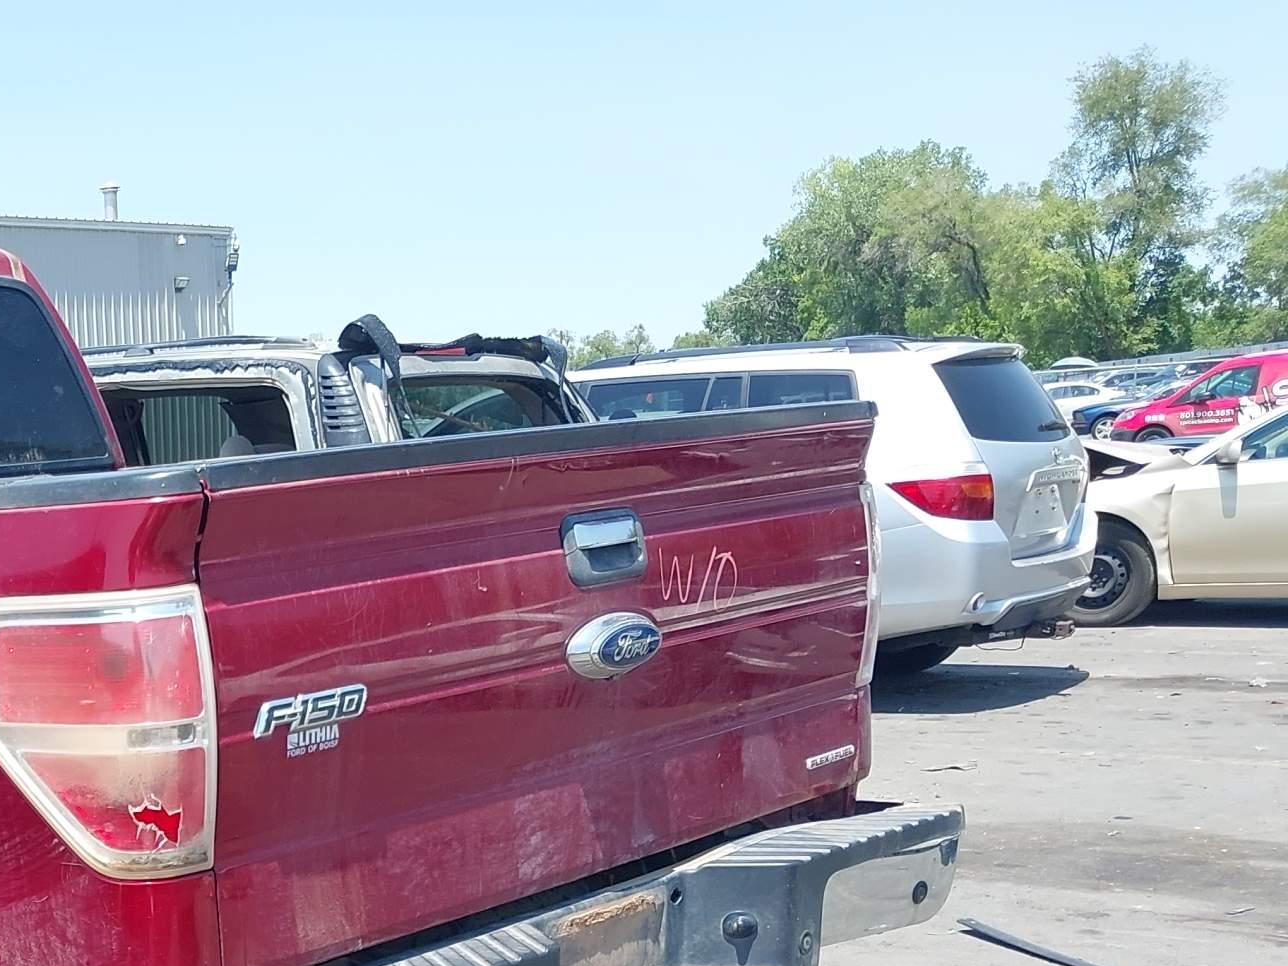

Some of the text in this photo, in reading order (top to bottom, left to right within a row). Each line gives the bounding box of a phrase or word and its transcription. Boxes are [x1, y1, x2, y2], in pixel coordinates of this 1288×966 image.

[613, 629, 661, 662] Ford
[253, 683, 368, 740] F-150
[300, 723, 339, 747] LITHIA
[287, 746, 306, 758] FORD
[308, 743, 318, 753] OF
[810, 747, 853, 768] FLEX FUEL
